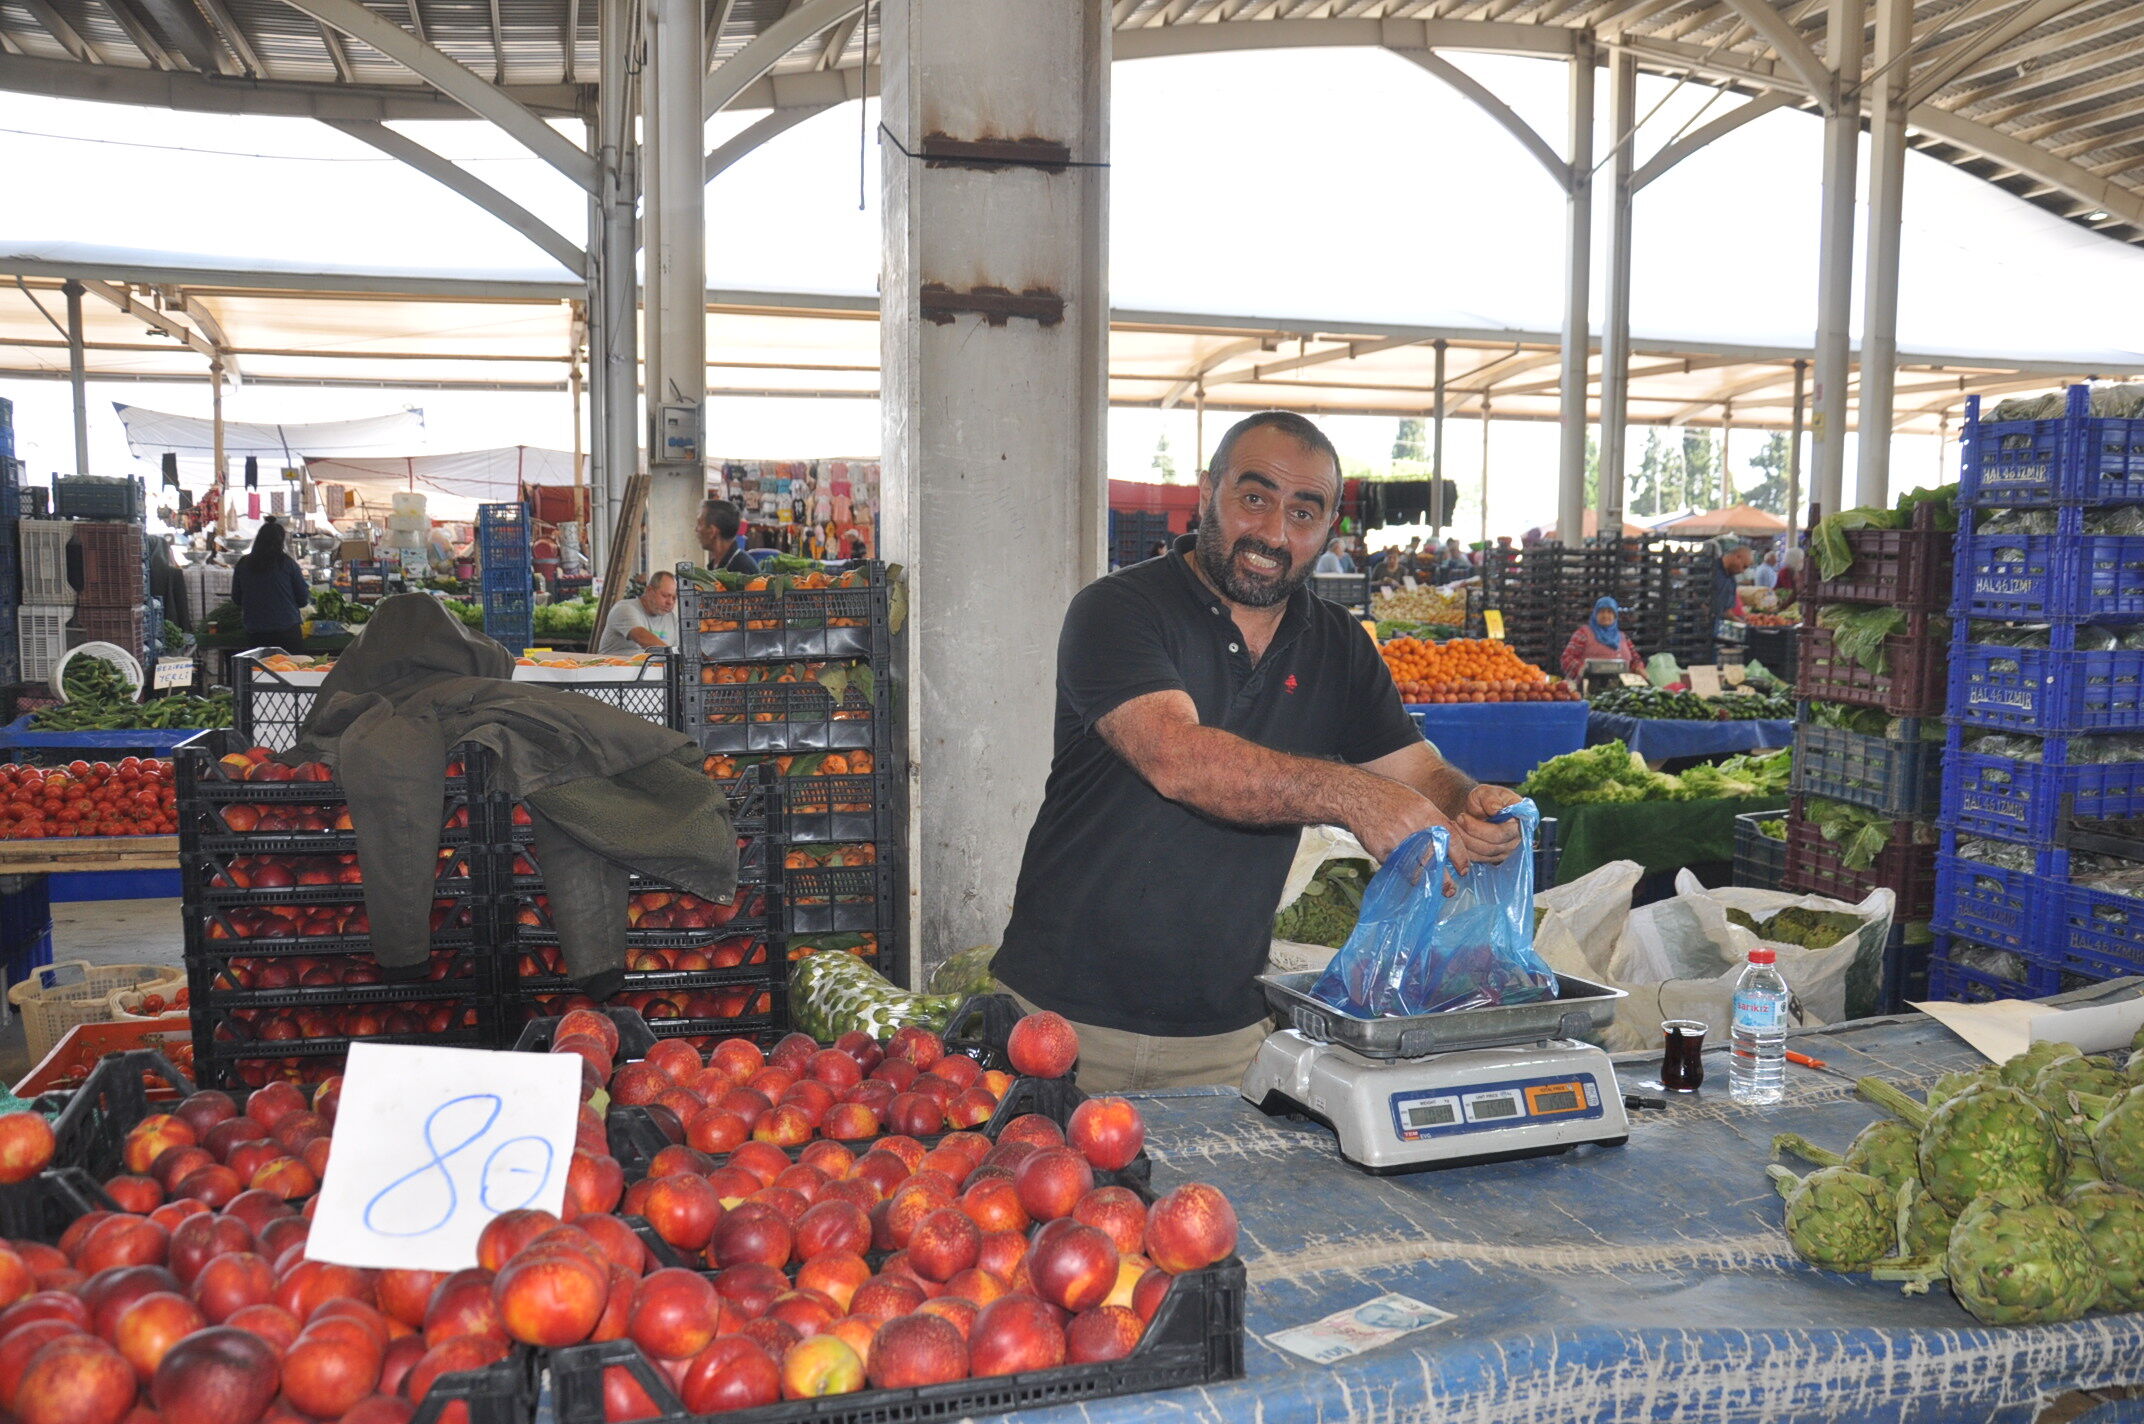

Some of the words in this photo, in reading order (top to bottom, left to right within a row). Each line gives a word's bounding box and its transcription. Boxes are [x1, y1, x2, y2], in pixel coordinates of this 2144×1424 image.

[1984, 466, 2001, 484] HAL
[1976, 578, 1994, 593] HAL
[1970, 687, 1988, 703] HAL
[1991, 688, 2002, 703] 46
[1964, 794, 1980, 810] HAL
[2070, 932, 2093, 949] HAL
[363, 1093, 555, 1238] 80
